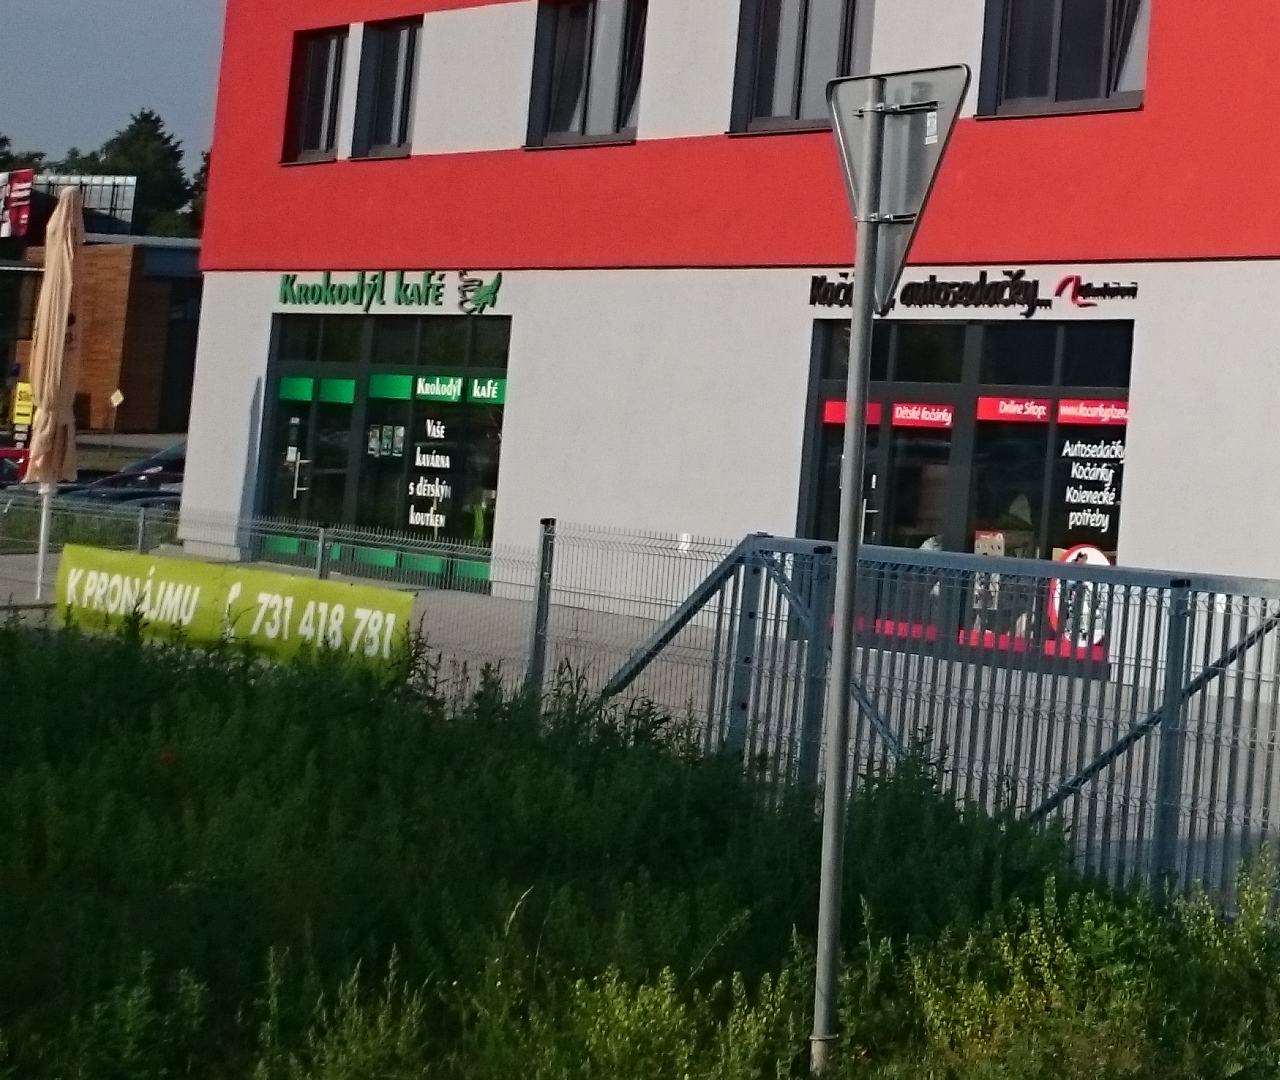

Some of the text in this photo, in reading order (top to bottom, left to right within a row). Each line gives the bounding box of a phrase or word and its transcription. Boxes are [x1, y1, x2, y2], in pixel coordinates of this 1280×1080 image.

[279, 270, 447, 314] Krokodýl kafé
[416, 377, 498, 400] Krokodýl kafé
[426, 419, 446, 439] Vaše
[415, 446, 450, 469] kavárna
[1070, 461, 1115, 487] Kočárky
[408, 481, 415, 496] s
[1068, 507, 1110, 533] potřeby
[66, 565, 397, 660] K PRONÁJMU 731 418 781
